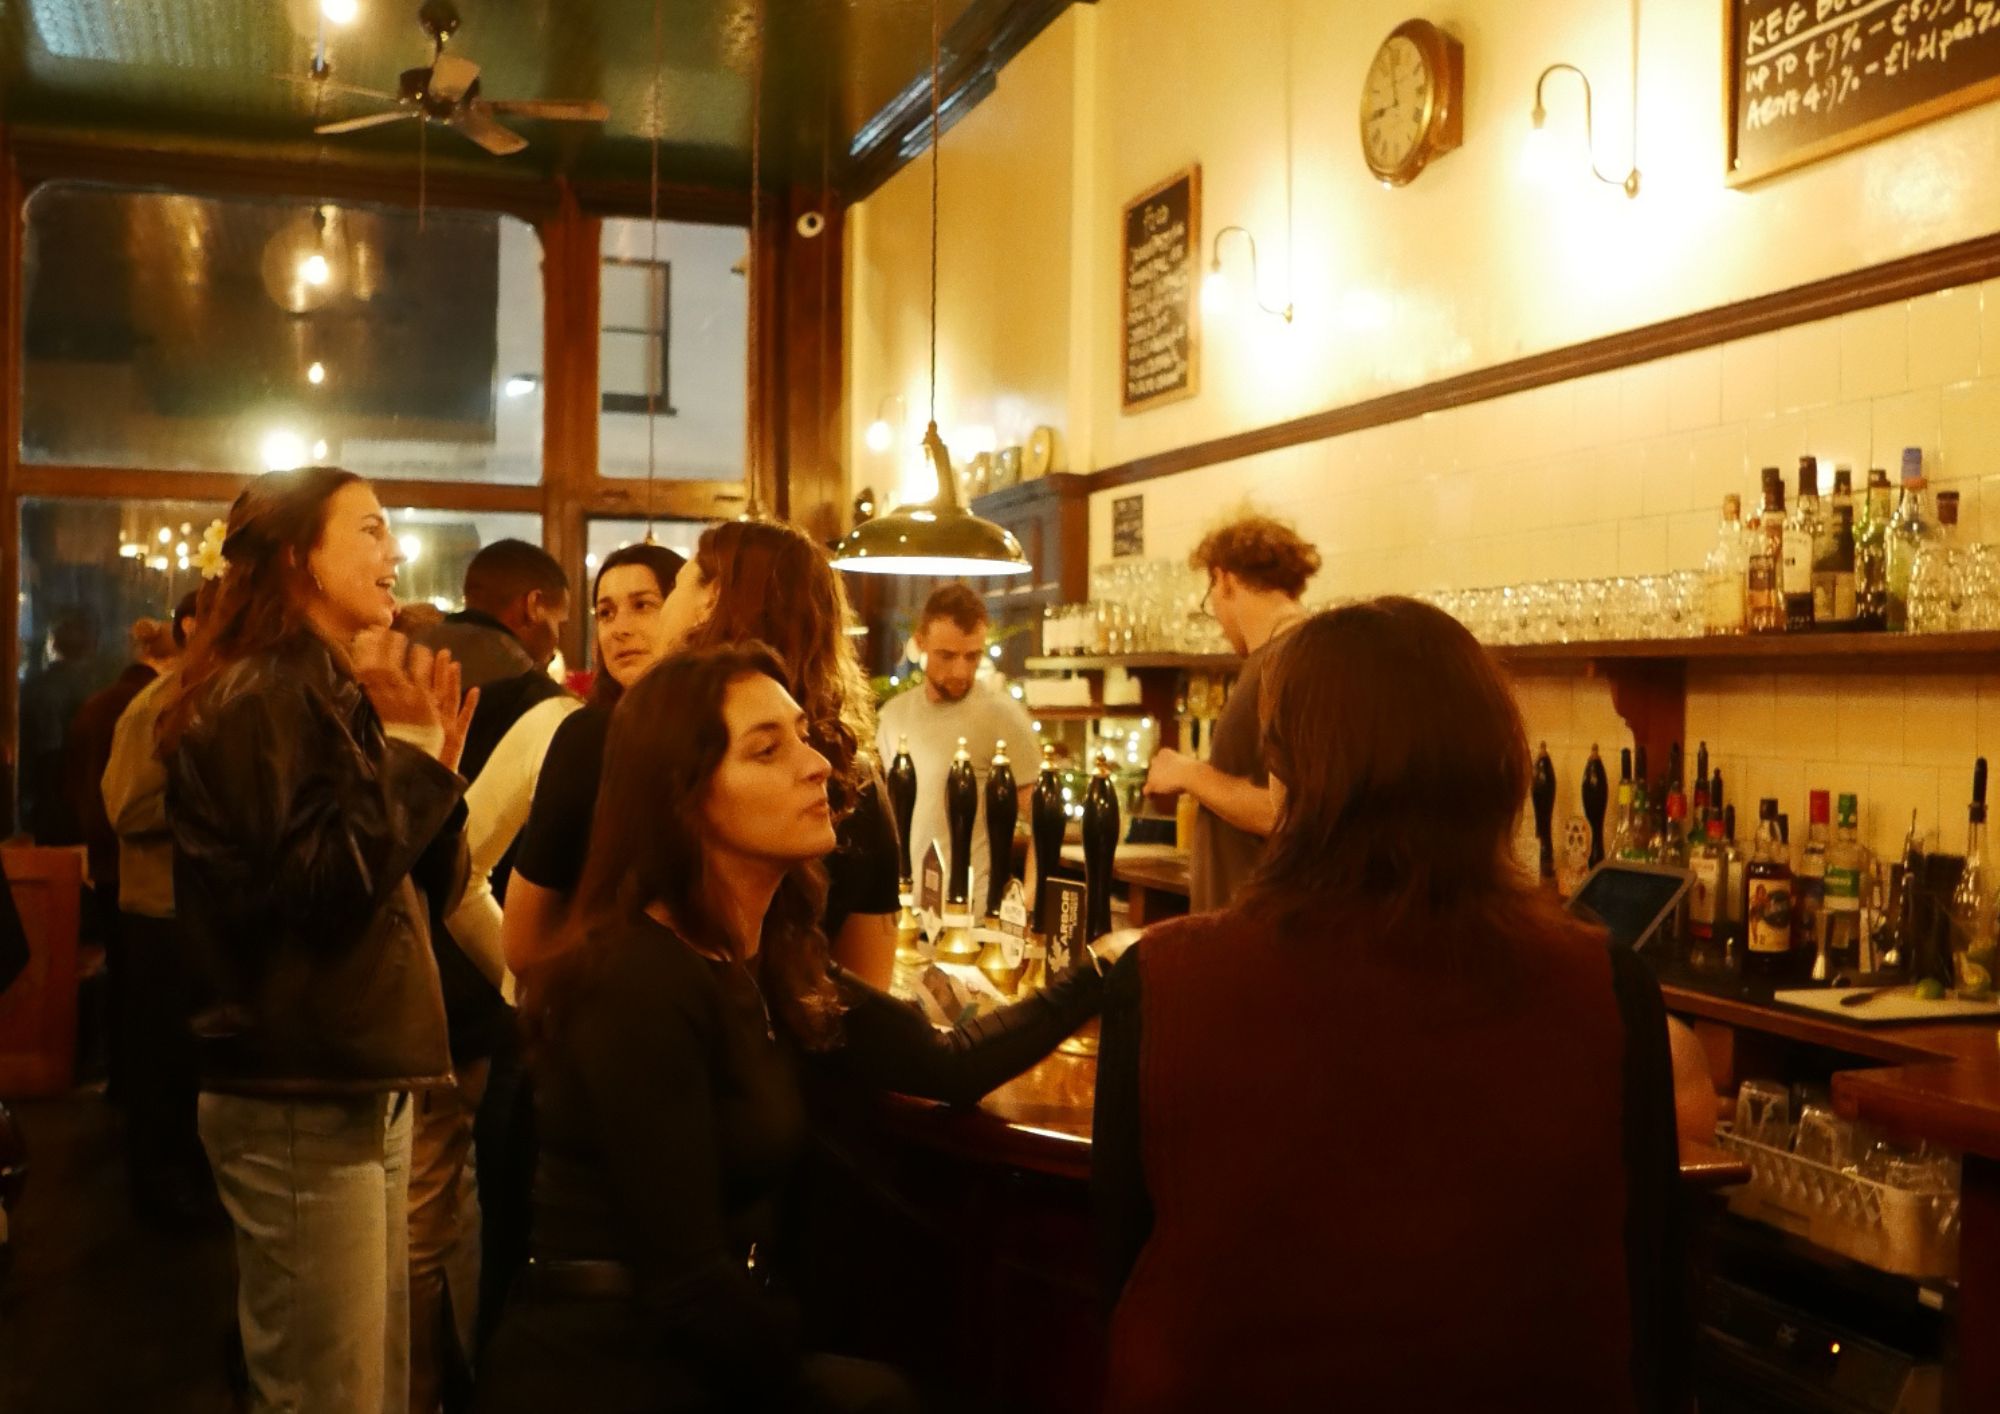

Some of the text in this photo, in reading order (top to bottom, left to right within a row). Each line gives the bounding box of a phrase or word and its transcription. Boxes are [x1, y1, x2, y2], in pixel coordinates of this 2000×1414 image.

[1748, 2, 1807, 54] KEG
[1776, 53, 1798, 83] TO
[1060, 890, 1070, 945] ARBOR
